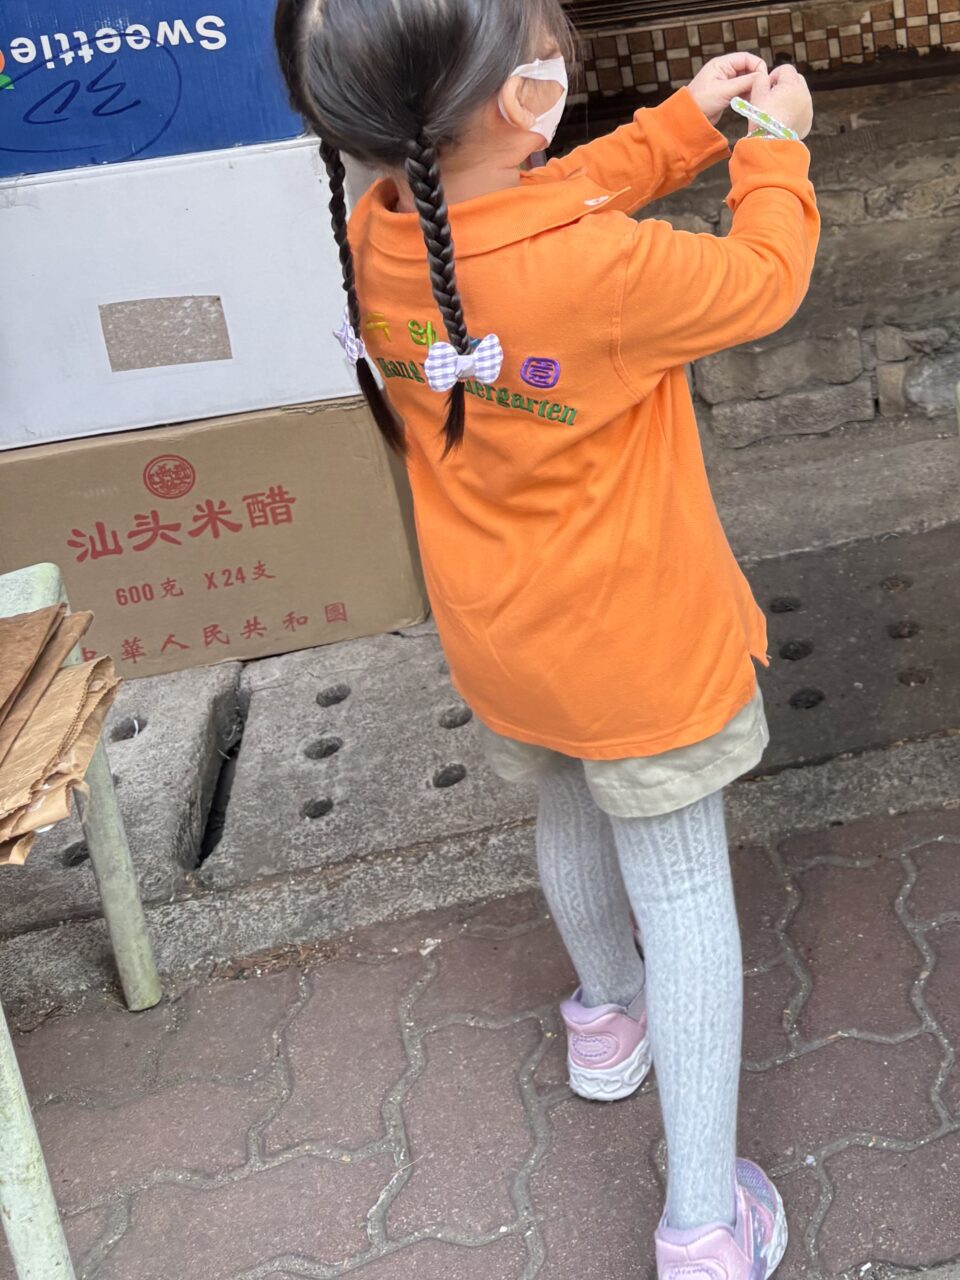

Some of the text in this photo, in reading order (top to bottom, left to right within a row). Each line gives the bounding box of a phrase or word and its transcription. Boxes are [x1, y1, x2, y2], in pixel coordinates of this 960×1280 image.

[10, 15, 227, 69] Sweettie
[67, 485, 298, 563] 汕头米醋
[115, 577, 184, 606] 600克
